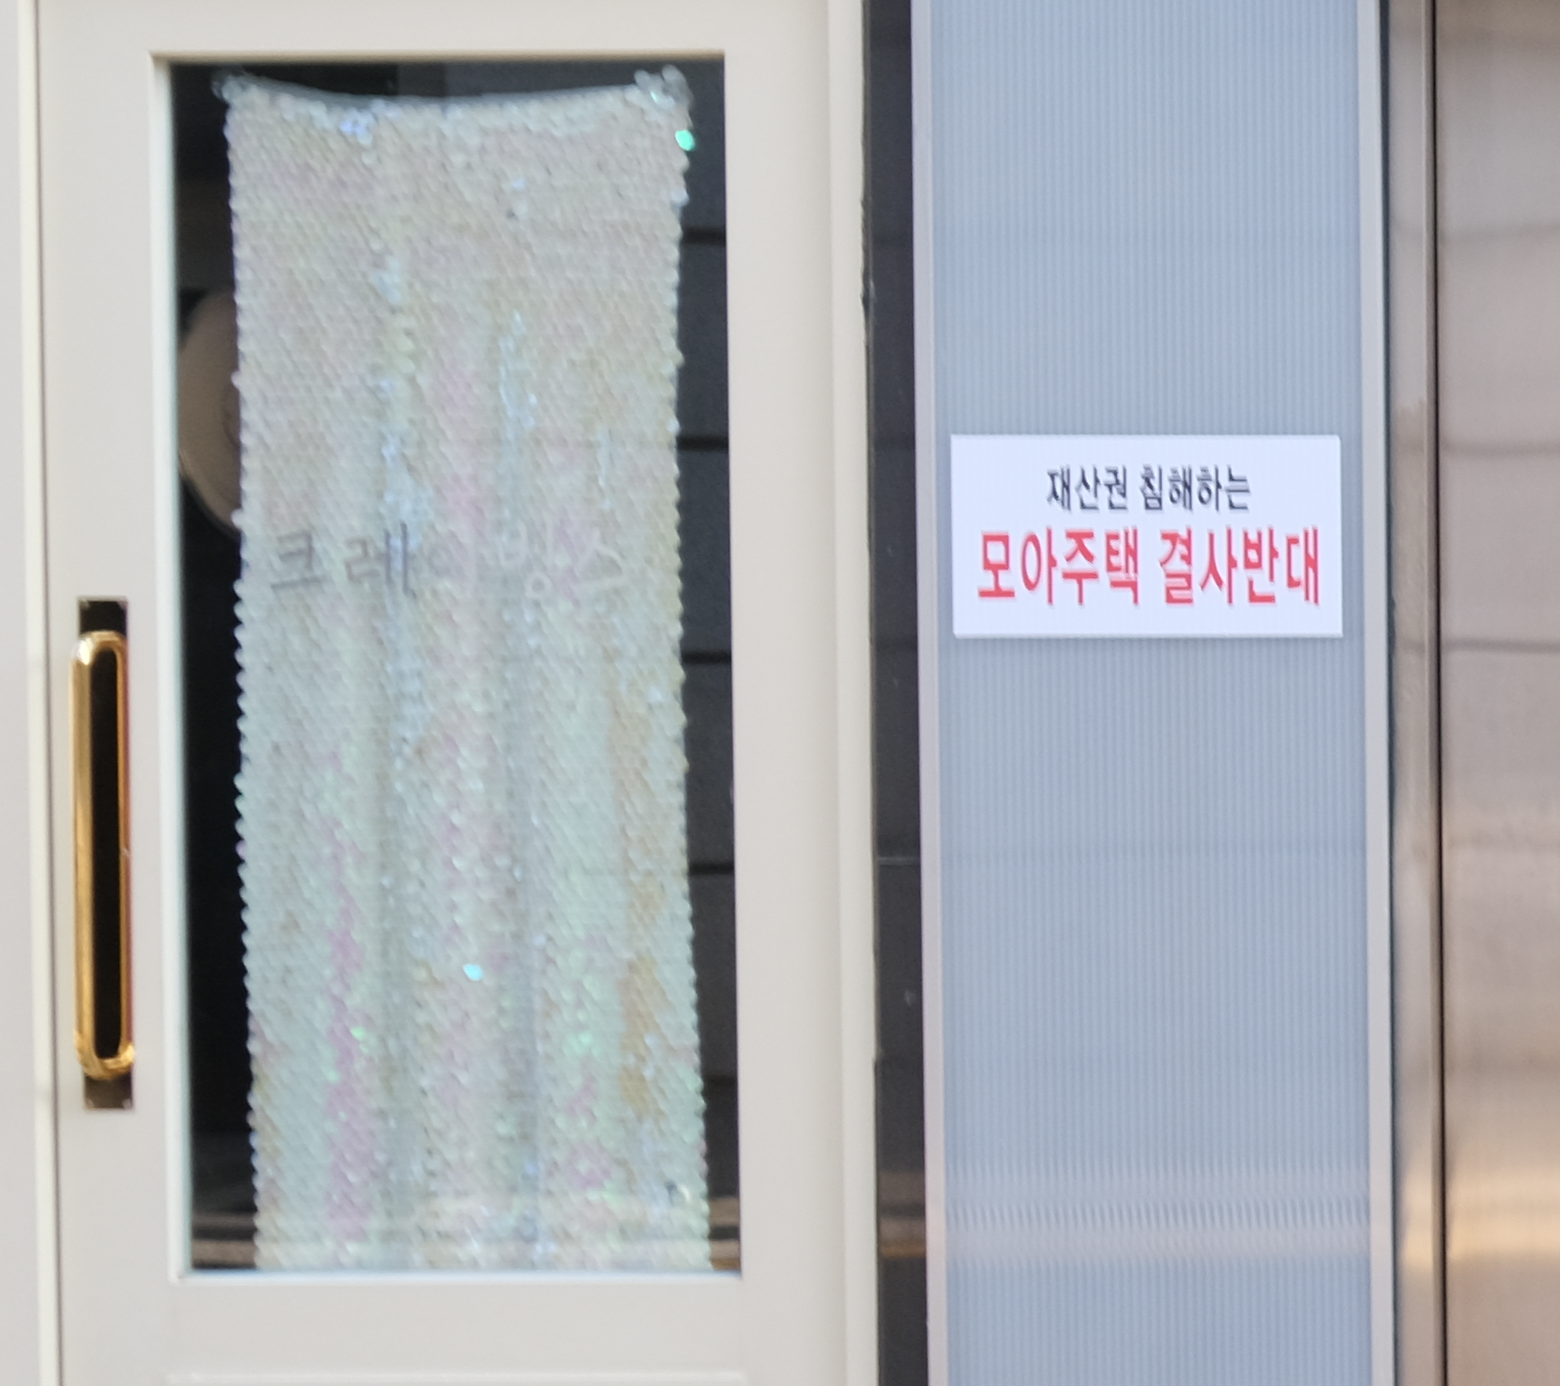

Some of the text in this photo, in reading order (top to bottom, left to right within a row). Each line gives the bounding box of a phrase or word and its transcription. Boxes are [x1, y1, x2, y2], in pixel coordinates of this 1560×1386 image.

[1046, 464, 1252, 512] 재산권 침해하는
[977, 525, 1322, 607] 모아주택 결사반대
